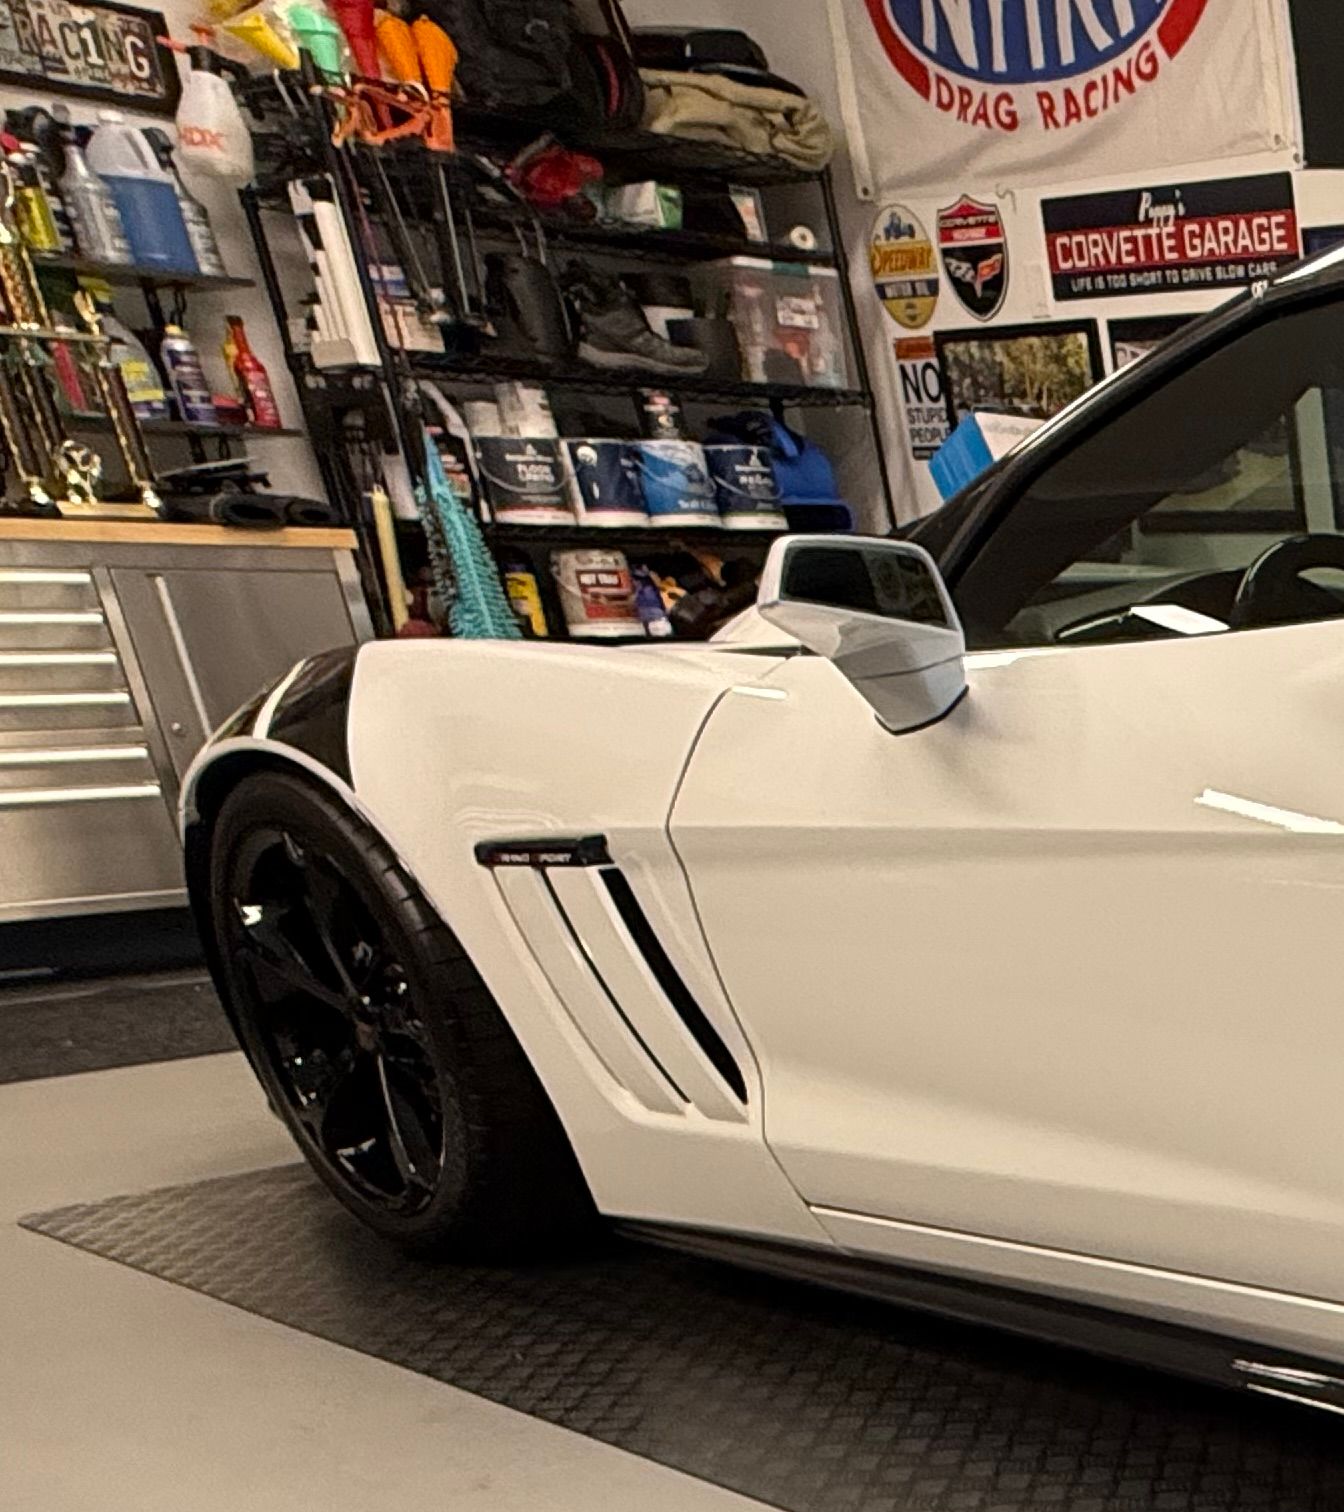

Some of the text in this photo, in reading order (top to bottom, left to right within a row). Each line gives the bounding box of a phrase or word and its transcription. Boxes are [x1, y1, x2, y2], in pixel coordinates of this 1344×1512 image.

[934, 40, 1160, 132] DRAG RACING
[1055, 214, 1289, 270] CORVETTE GARAGE
[899, 362, 942, 403] NO
